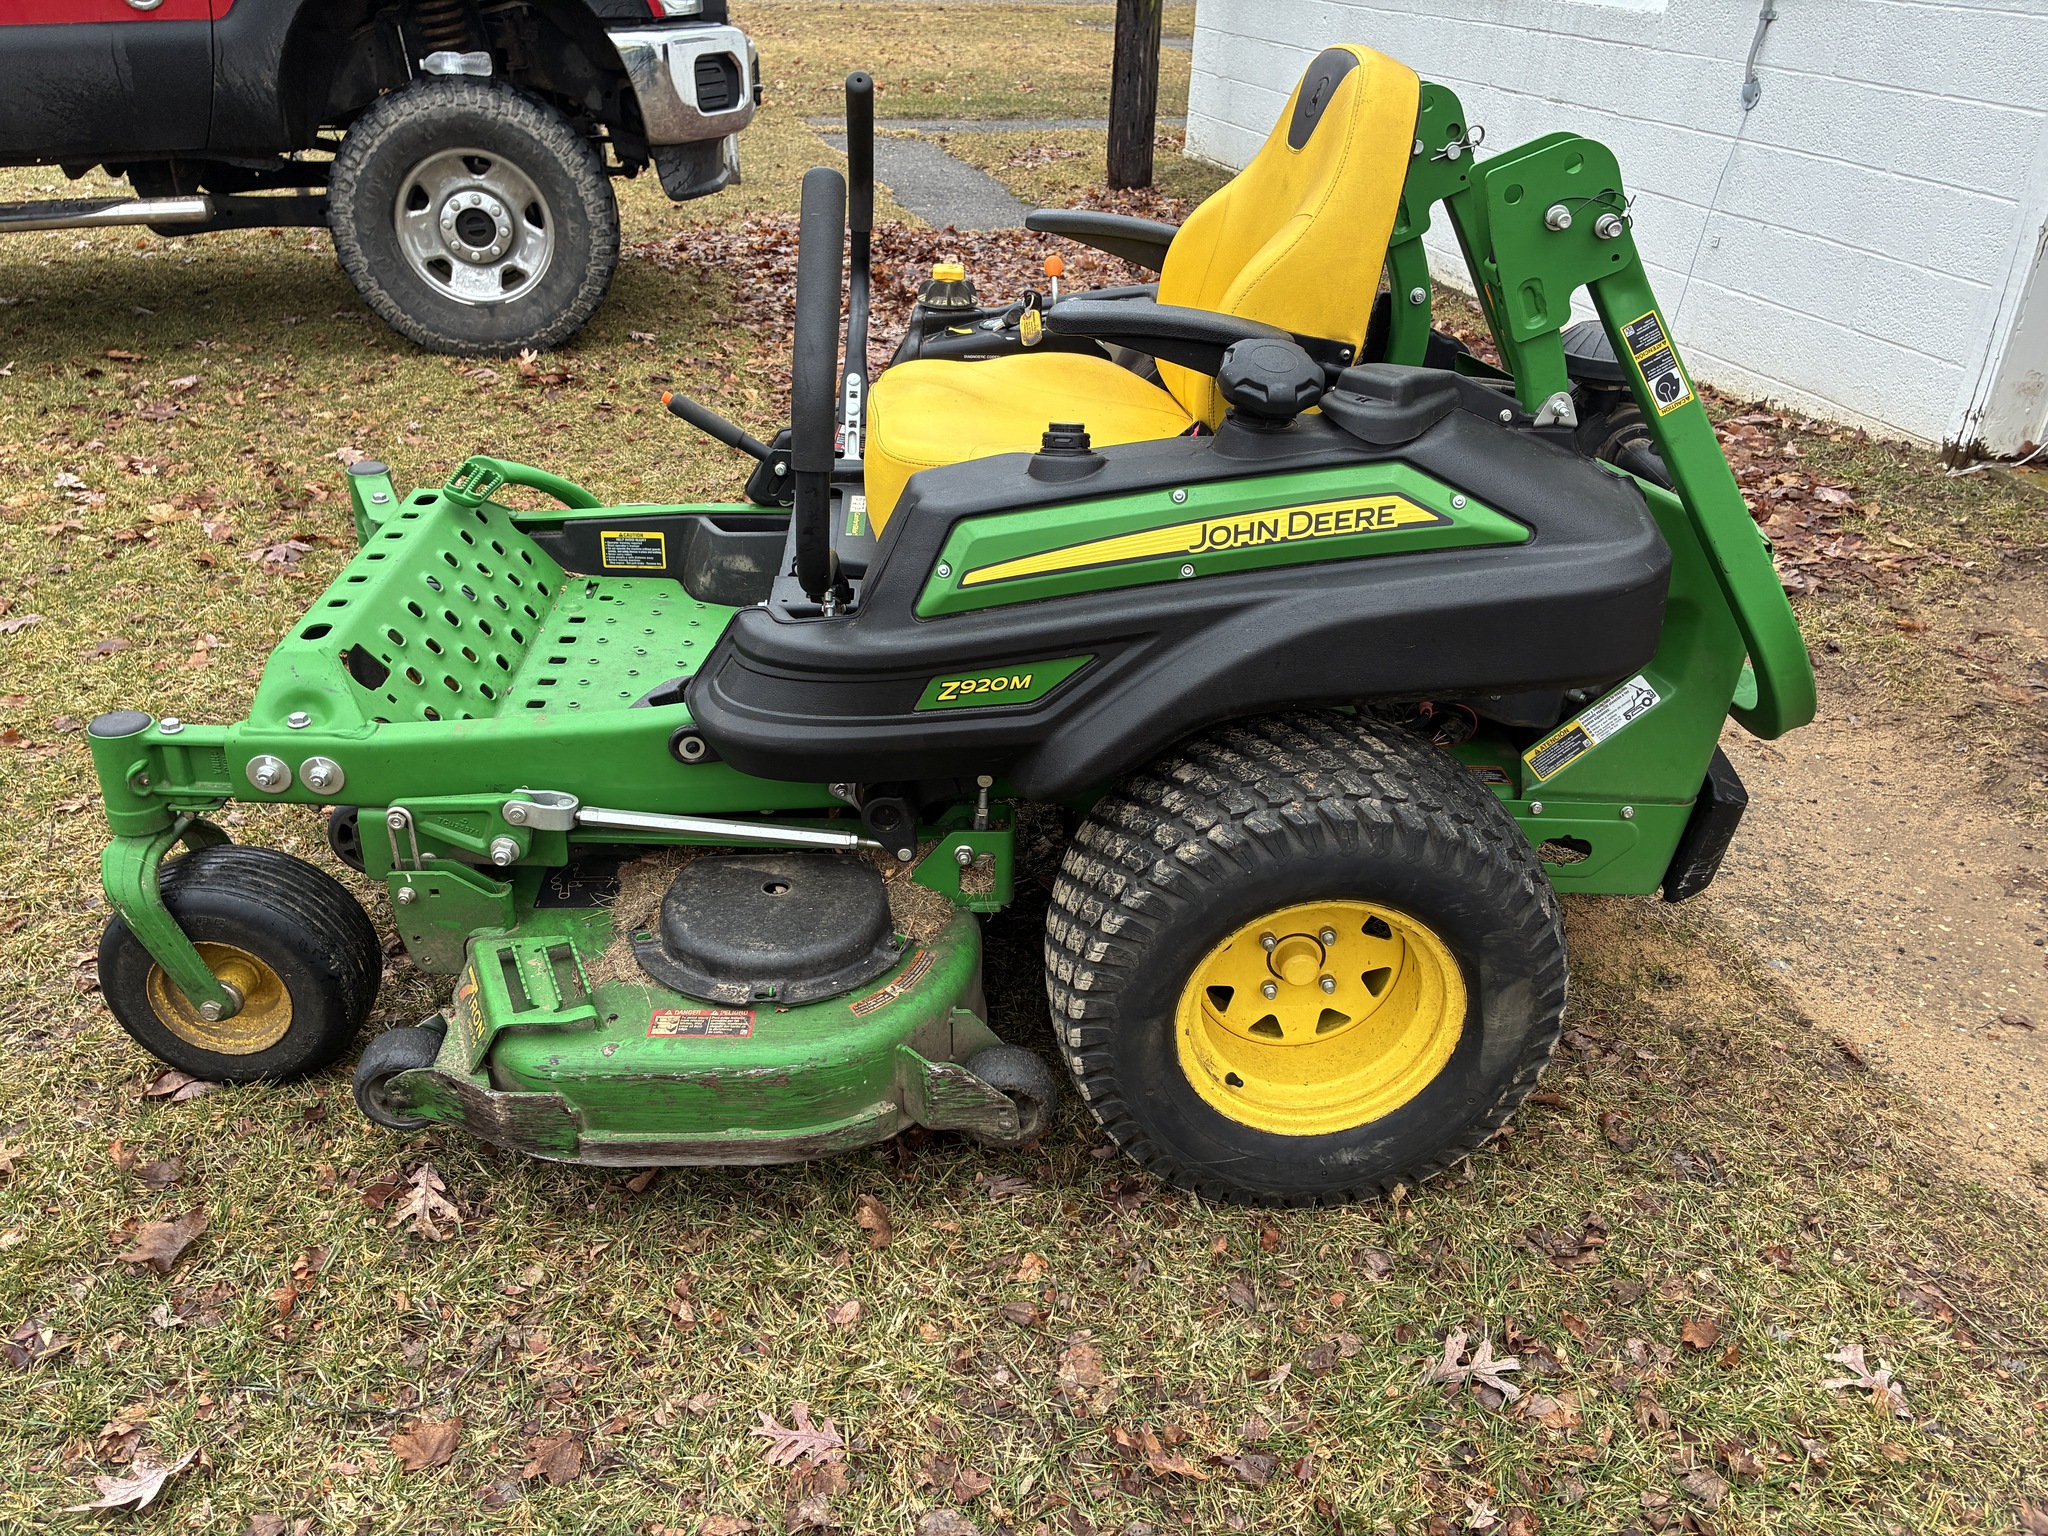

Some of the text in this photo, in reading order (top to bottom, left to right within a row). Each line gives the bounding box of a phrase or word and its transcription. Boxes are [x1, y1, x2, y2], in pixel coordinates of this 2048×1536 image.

[1661, 396, 1686, 414] CAUTION
[1189, 504, 1397, 550] JOHN DEERE
[937, 674, 1033, 701] Z920M
[1540, 727, 1570, 751] ATENCIÓN
